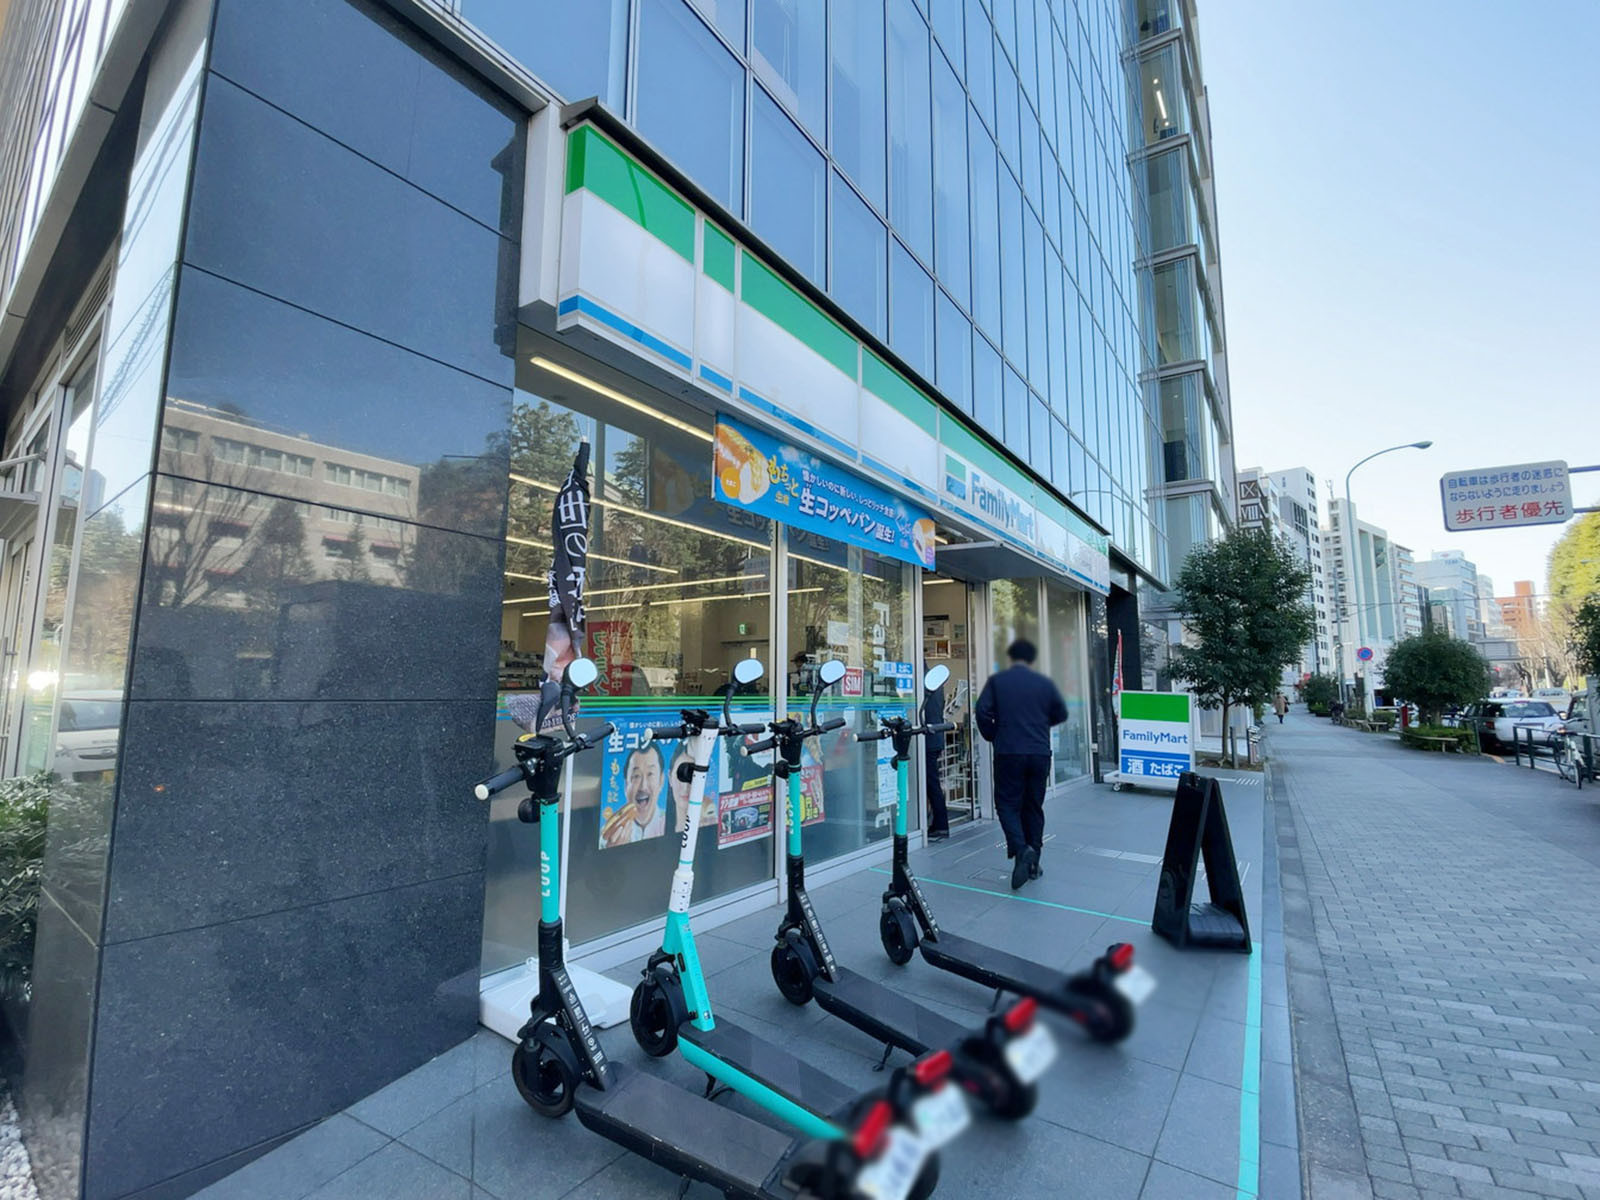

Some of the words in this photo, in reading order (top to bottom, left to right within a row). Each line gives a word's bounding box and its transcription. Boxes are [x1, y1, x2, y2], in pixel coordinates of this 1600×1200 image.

[1448, 467, 1564, 489] 自転車は歩行者の迷惑に
[1450, 481, 1565, 502] ならないように走りましょう
[971, 471, 1034, 541] FamilyMart
[1456, 500, 1565, 524] 歩行者優先
[845, 675, 861, 691] SIM
[1123, 729, 1188, 744] FamilyMart
[1127, 758, 1144, 775] 酒
[1149, 761, 1184, 777] たばこ
[541, 850, 551, 897] LUUP
